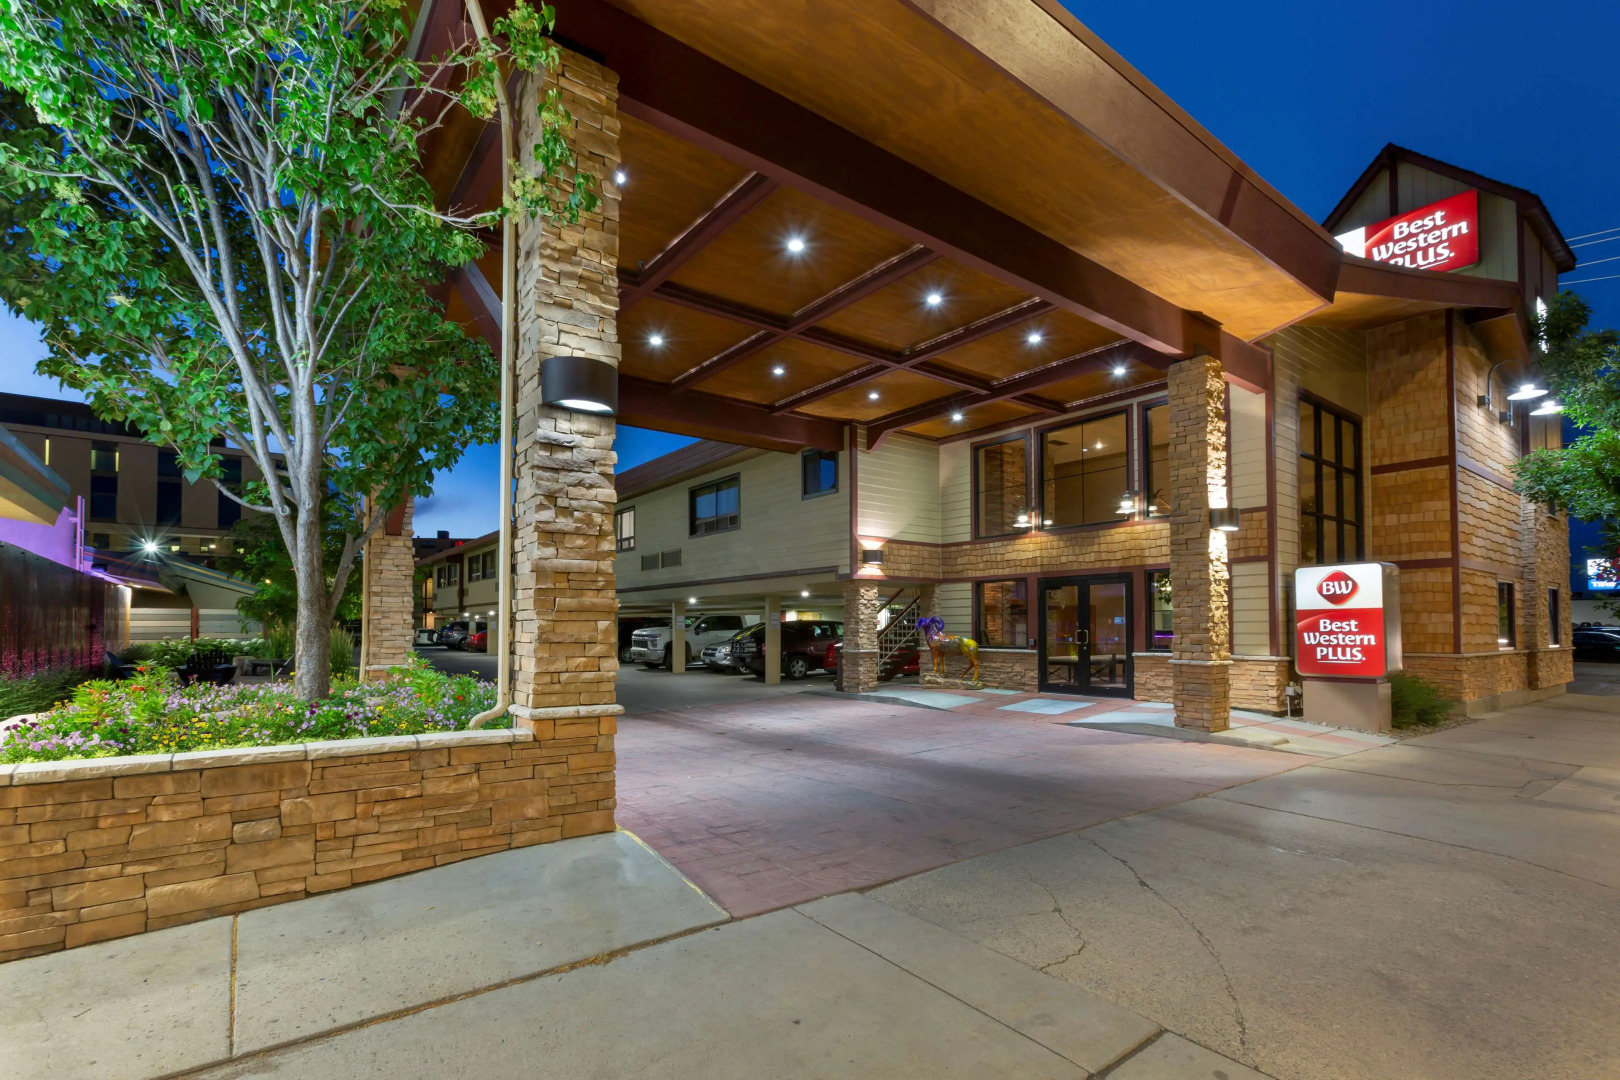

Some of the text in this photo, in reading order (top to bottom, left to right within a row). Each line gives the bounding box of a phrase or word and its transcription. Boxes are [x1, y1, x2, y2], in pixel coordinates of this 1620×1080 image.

[1393, 210, 1446, 240] Best
[1372, 221, 1469, 261] Western
[1322, 580, 1353, 595] BW
[1320, 619, 1359, 632] Best
[1303, 632, 1376, 645] Western
